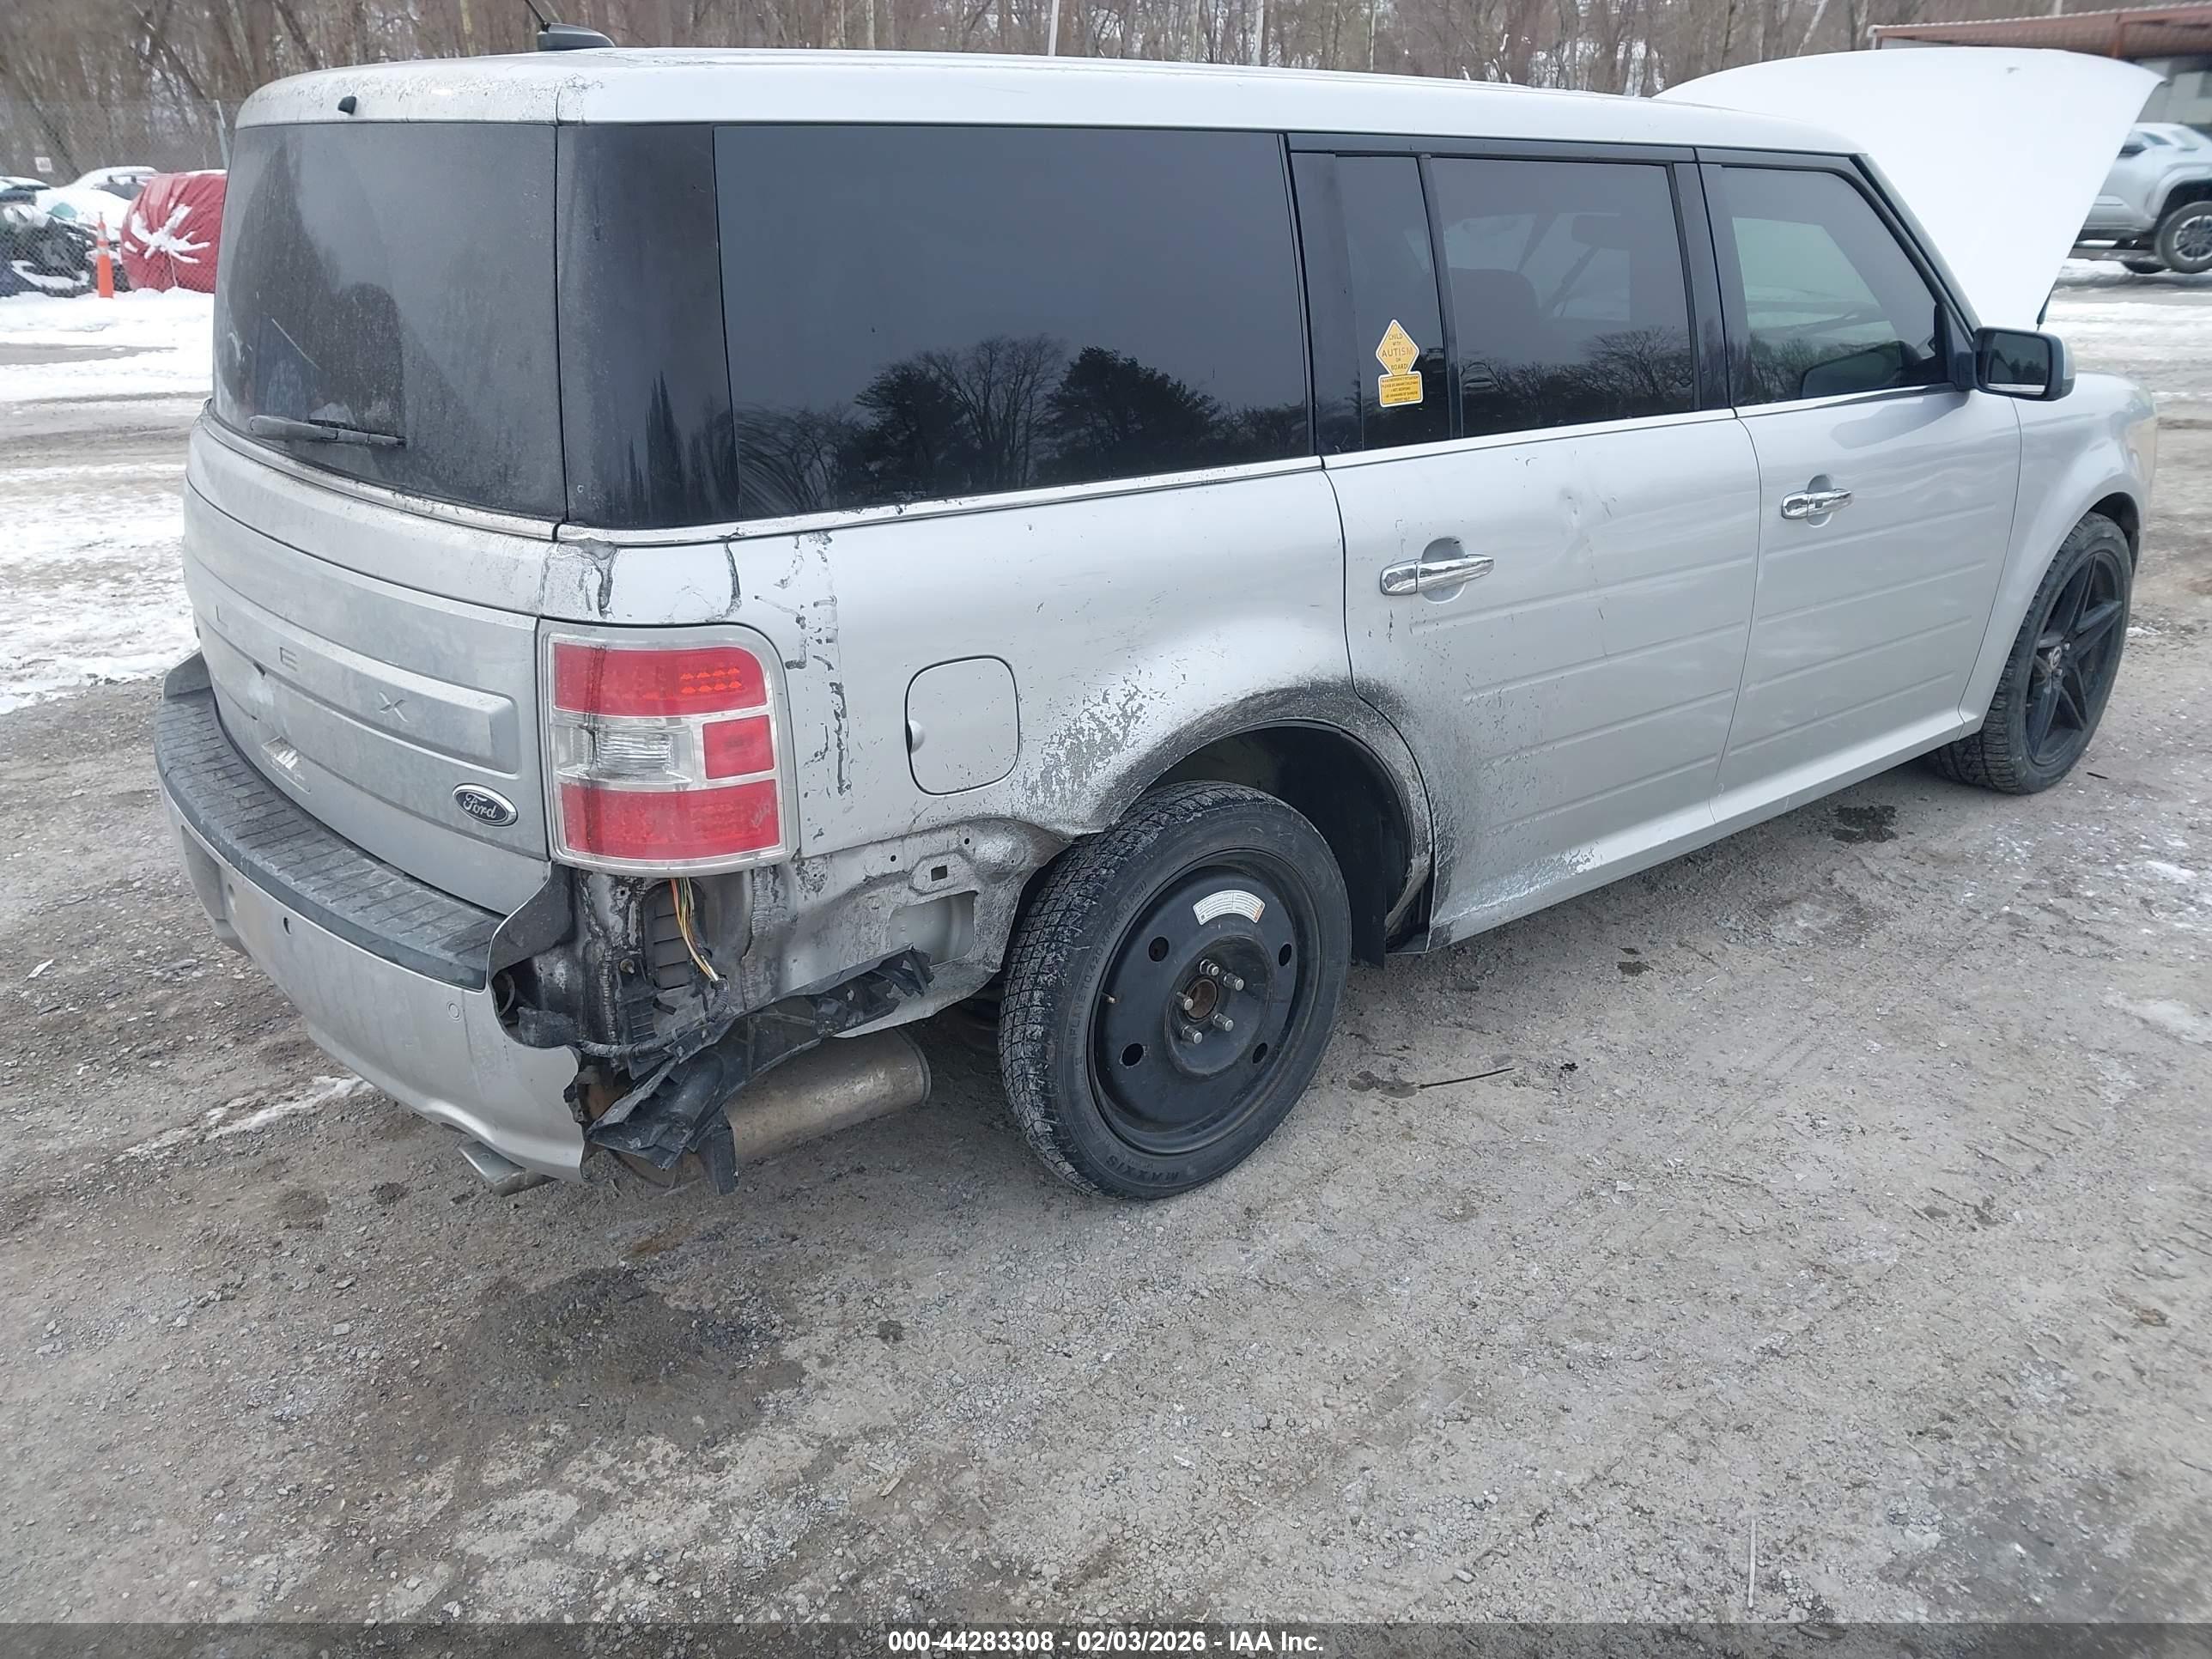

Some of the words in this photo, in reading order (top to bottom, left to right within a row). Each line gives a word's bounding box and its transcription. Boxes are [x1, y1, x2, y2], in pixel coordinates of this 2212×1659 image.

[1382, 347, 1413, 357] AUTISM
[463, 793, 497, 819] Ford
[1106, 1155, 1180, 1181] MAXXIS
